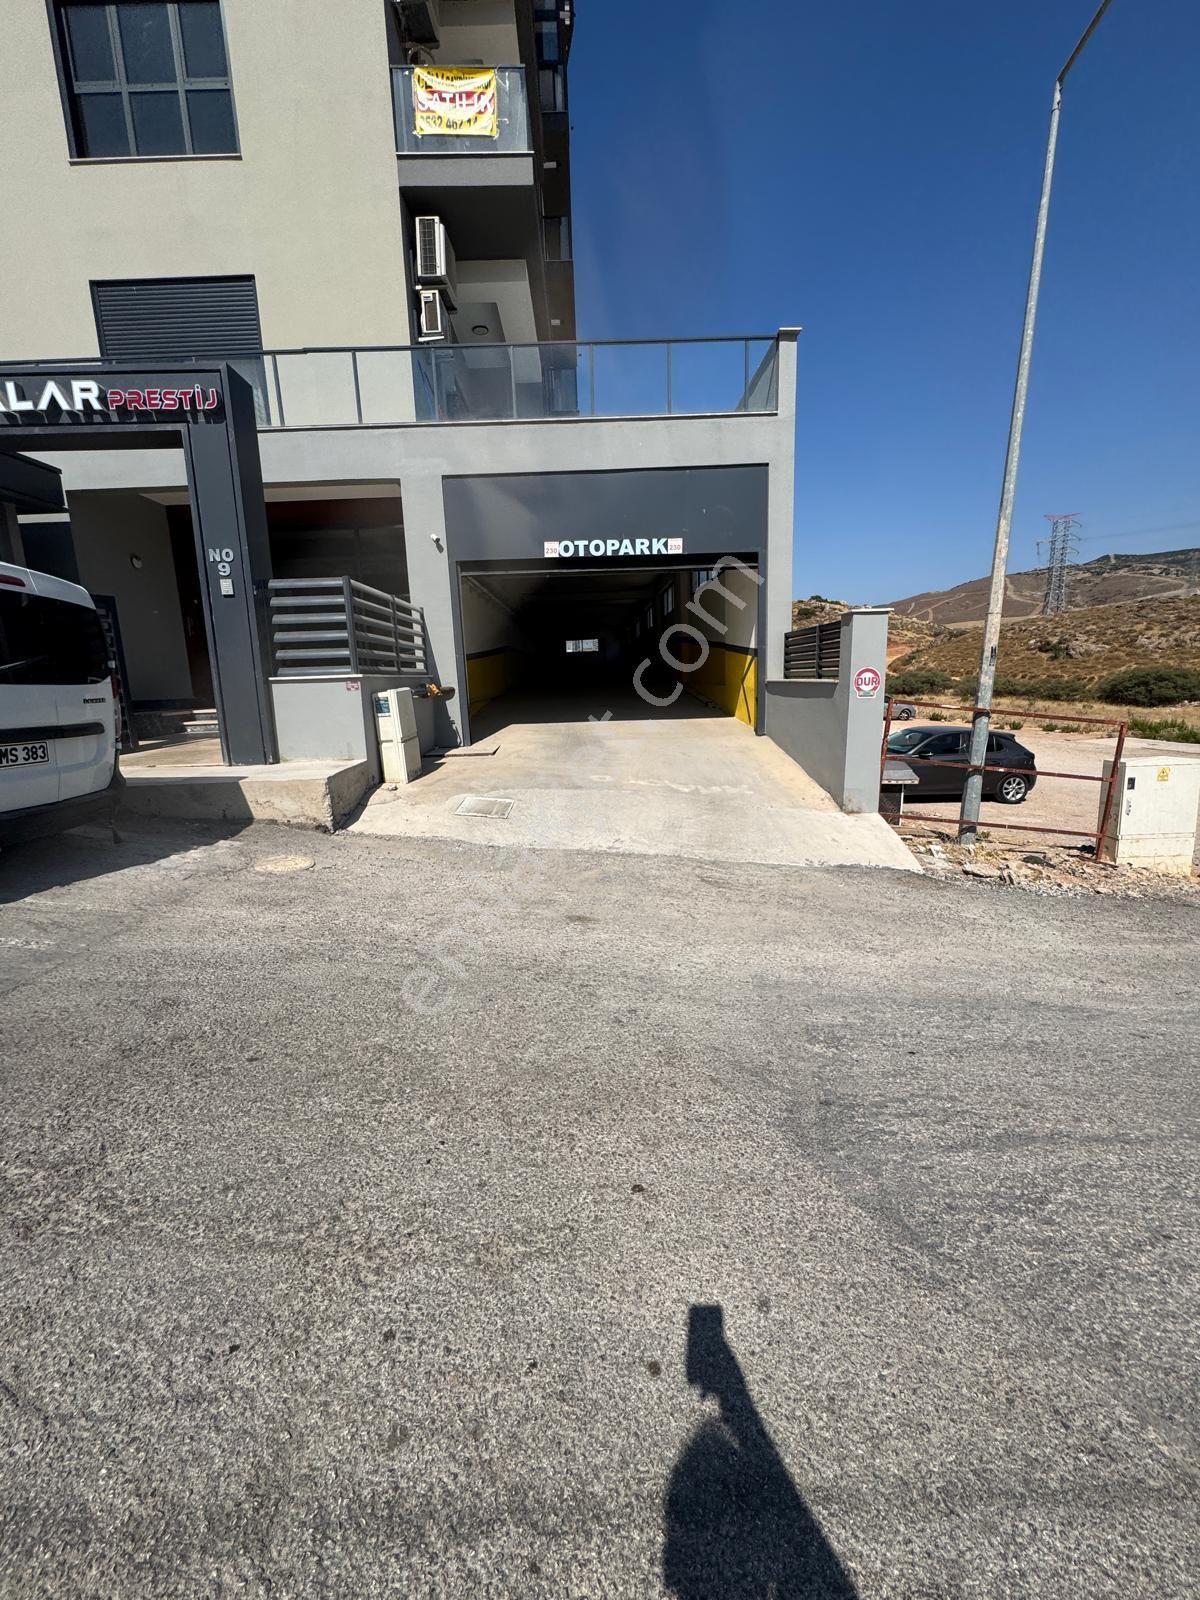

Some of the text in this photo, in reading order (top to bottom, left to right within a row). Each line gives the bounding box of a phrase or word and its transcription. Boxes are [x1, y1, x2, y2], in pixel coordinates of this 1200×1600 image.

[558, 538, 668, 557] OTOPARK
[208, 548, 234, 562] NO
[217, 562, 231, 576] 9
[856, 677, 878, 686] DUR
[22, 744, 46, 761] 383
